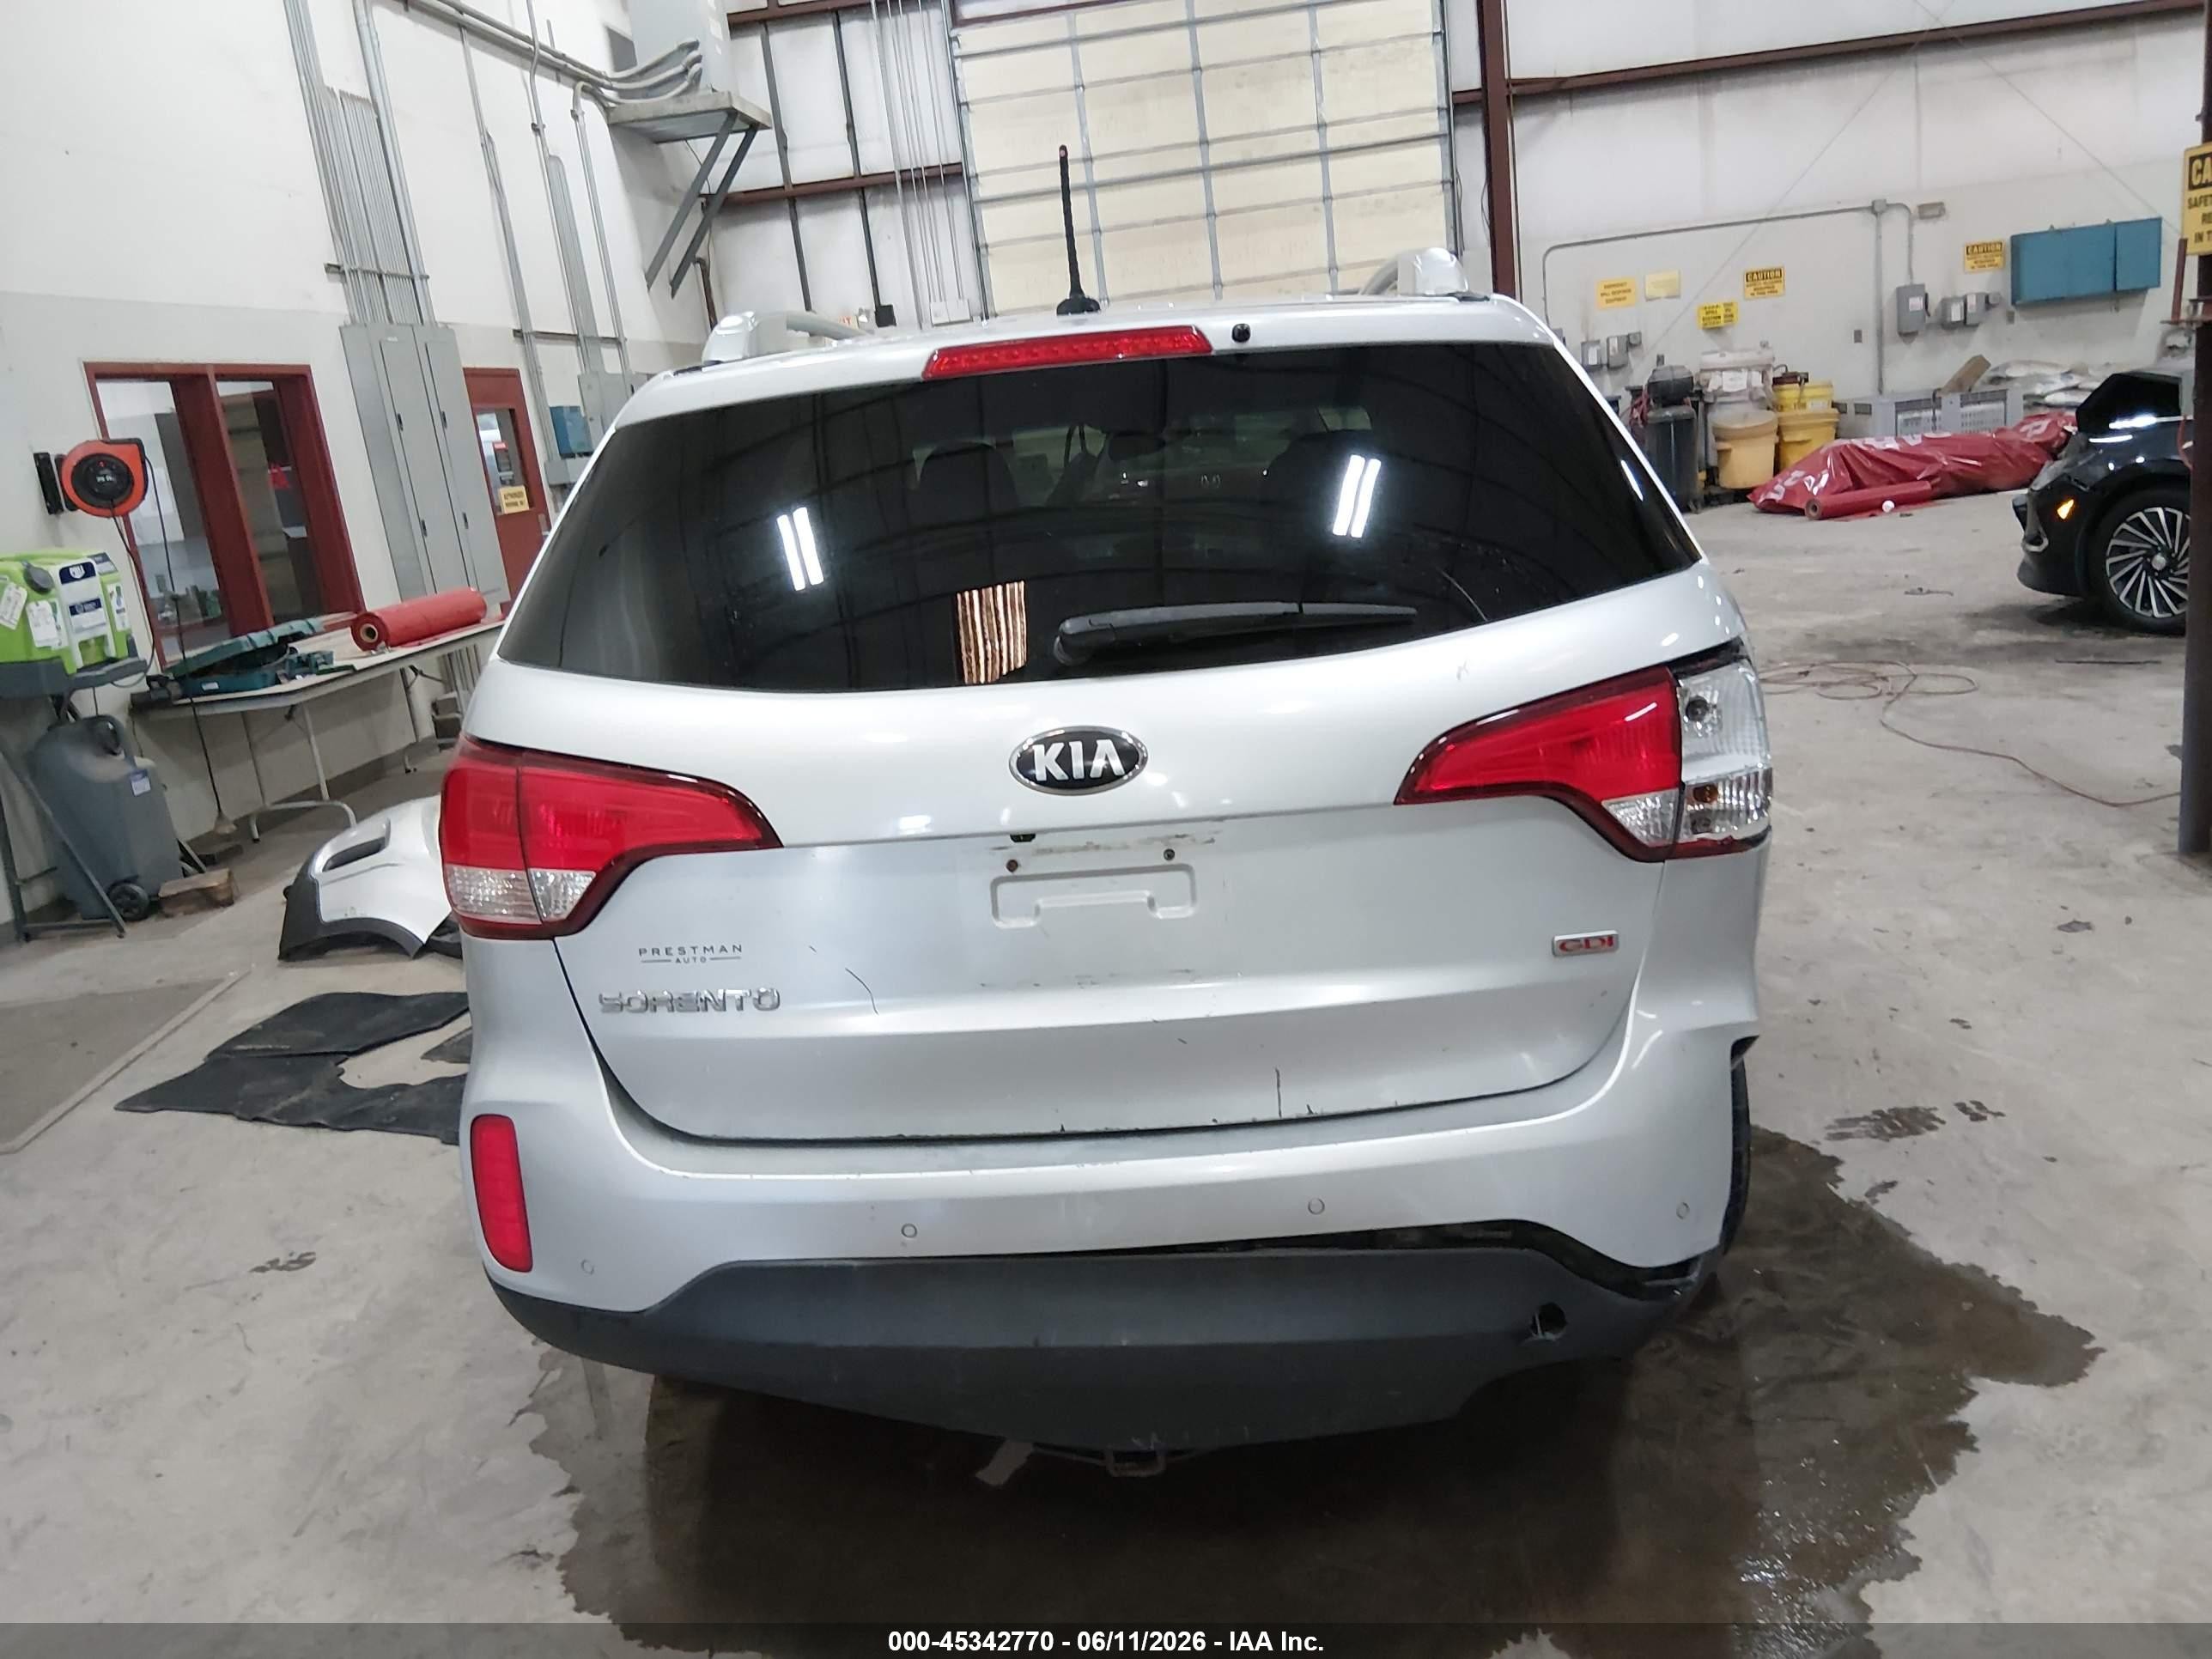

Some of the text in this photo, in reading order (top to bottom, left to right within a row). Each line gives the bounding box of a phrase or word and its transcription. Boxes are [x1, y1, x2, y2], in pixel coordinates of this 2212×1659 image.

[1967, 242, 2002, 255] CAUTION
[1747, 269, 1781, 282] CAUTION
[1032, 738, 1126, 781] KIA
[1559, 934, 1614, 952] GDI
[638, 944, 743, 957] PRESTMAN
[674, 956, 707, 964] AUTO
[599, 988, 781, 1013] SORENTO
